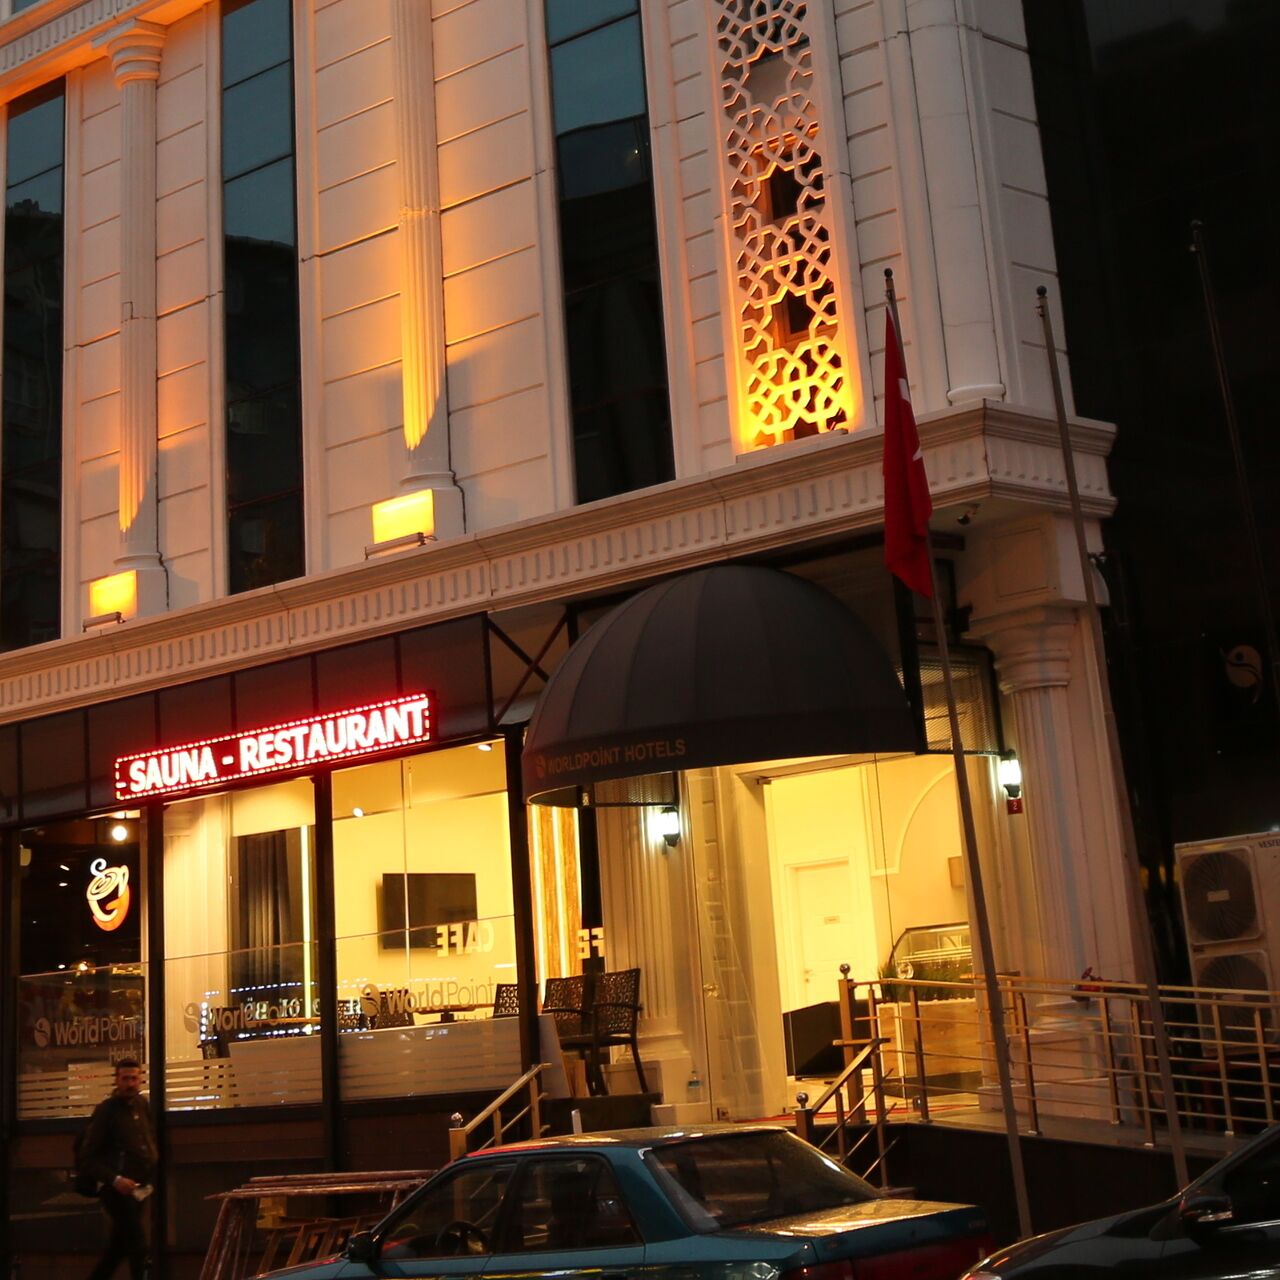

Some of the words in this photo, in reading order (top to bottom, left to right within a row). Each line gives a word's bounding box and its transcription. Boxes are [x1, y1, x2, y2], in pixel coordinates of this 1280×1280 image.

[129, 746, 218, 793] SAUNA
[239, 701, 428, 773] RESTAURANT
[624, 738, 687, 761] HOTELS
[386, 976, 497, 1016] WorldPoint
[54, 1016, 137, 1045] WorldPoint
